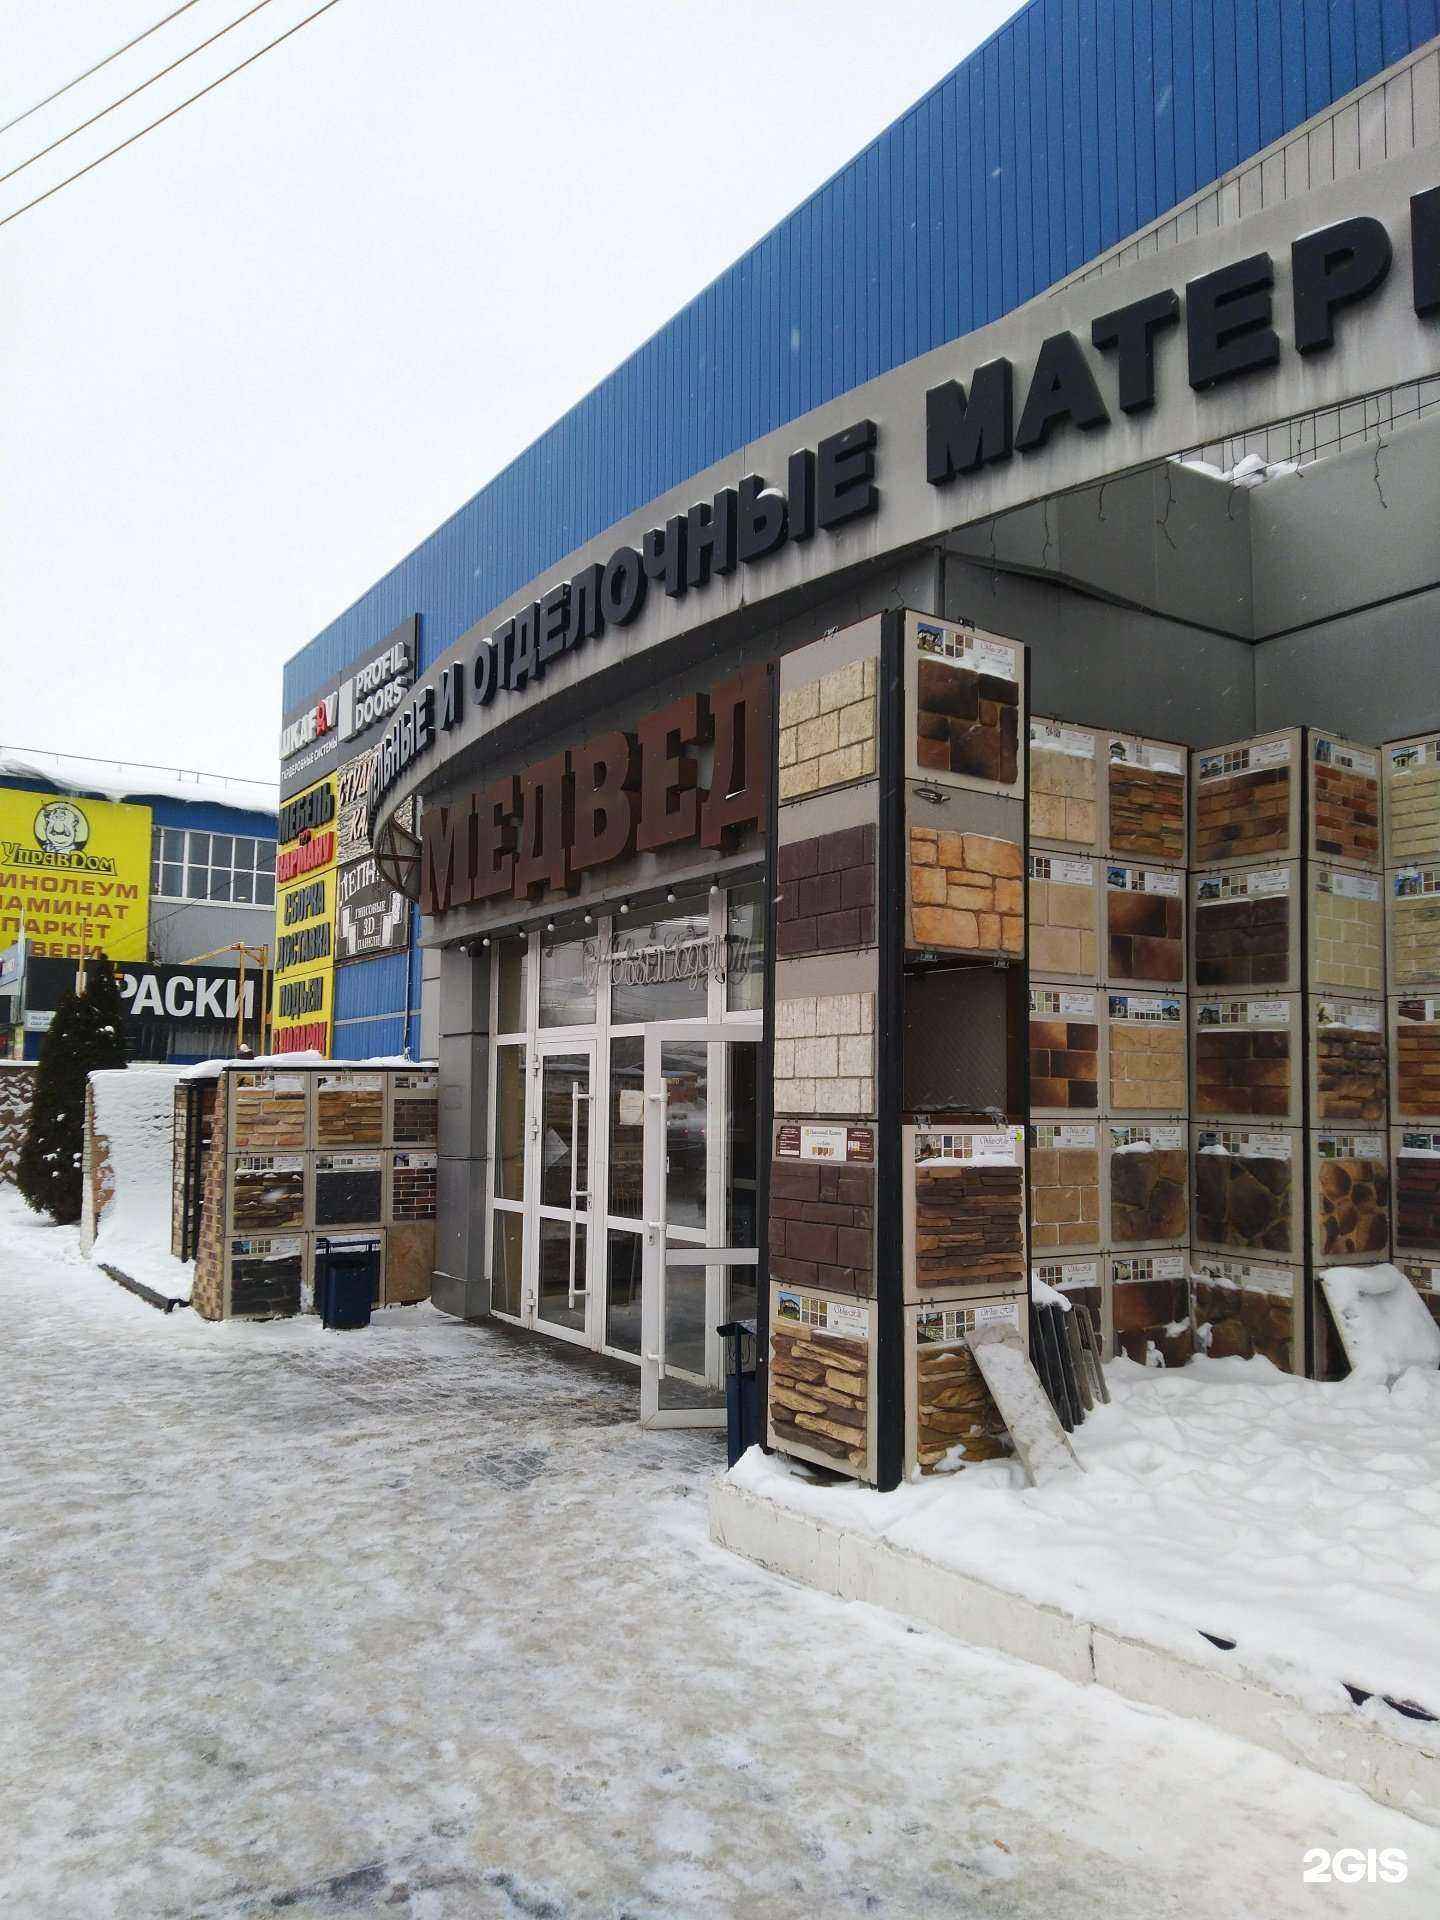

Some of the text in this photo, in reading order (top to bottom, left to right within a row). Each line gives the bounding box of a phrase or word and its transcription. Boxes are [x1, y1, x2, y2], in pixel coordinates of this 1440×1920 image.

[440, 661, 463, 731] И
[472, 419, 879, 706] ОТДЕЛОЧНЫЕ
[355, 641, 408, 698] PROFIL
[355, 676, 409, 731] DOORS
[279, 783, 334, 845] МЕБЕЛЬ
[276, 832, 334, 883] КАРМАНУ
[339, 857, 385, 907] ЛЕПН
[0, 895, 129, 920] АМИНАТ
[2, 916, 111, 940] ПАРКЕТ
[284, 880, 325, 926] СБОРКА
[363, 916, 375, 936] 3D
[275, 922, 331, 974] ДОСТАВКА
